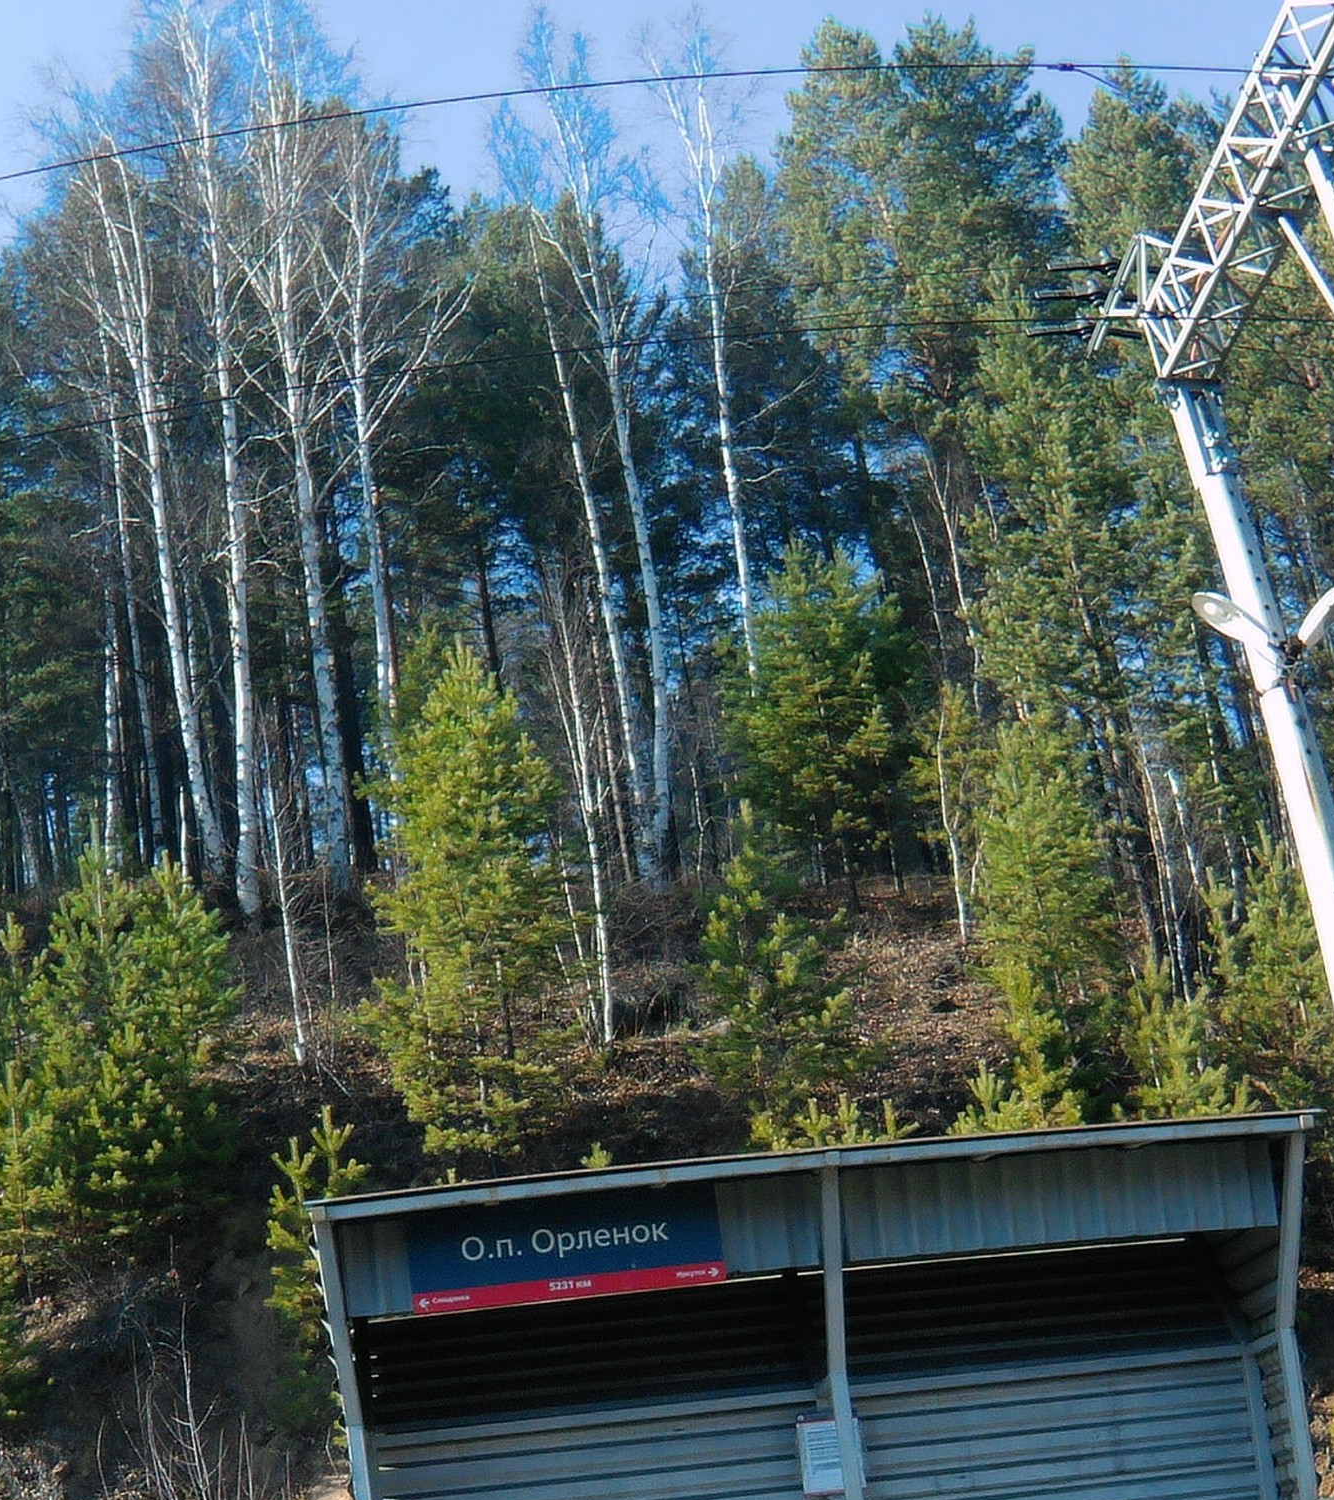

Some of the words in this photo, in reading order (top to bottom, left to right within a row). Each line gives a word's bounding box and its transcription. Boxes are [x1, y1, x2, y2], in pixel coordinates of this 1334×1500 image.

[461, 1236, 523, 1261] О.п.
[531, 1221, 669, 1258] Орленок
[548, 1280, 574, 1292] 5231
